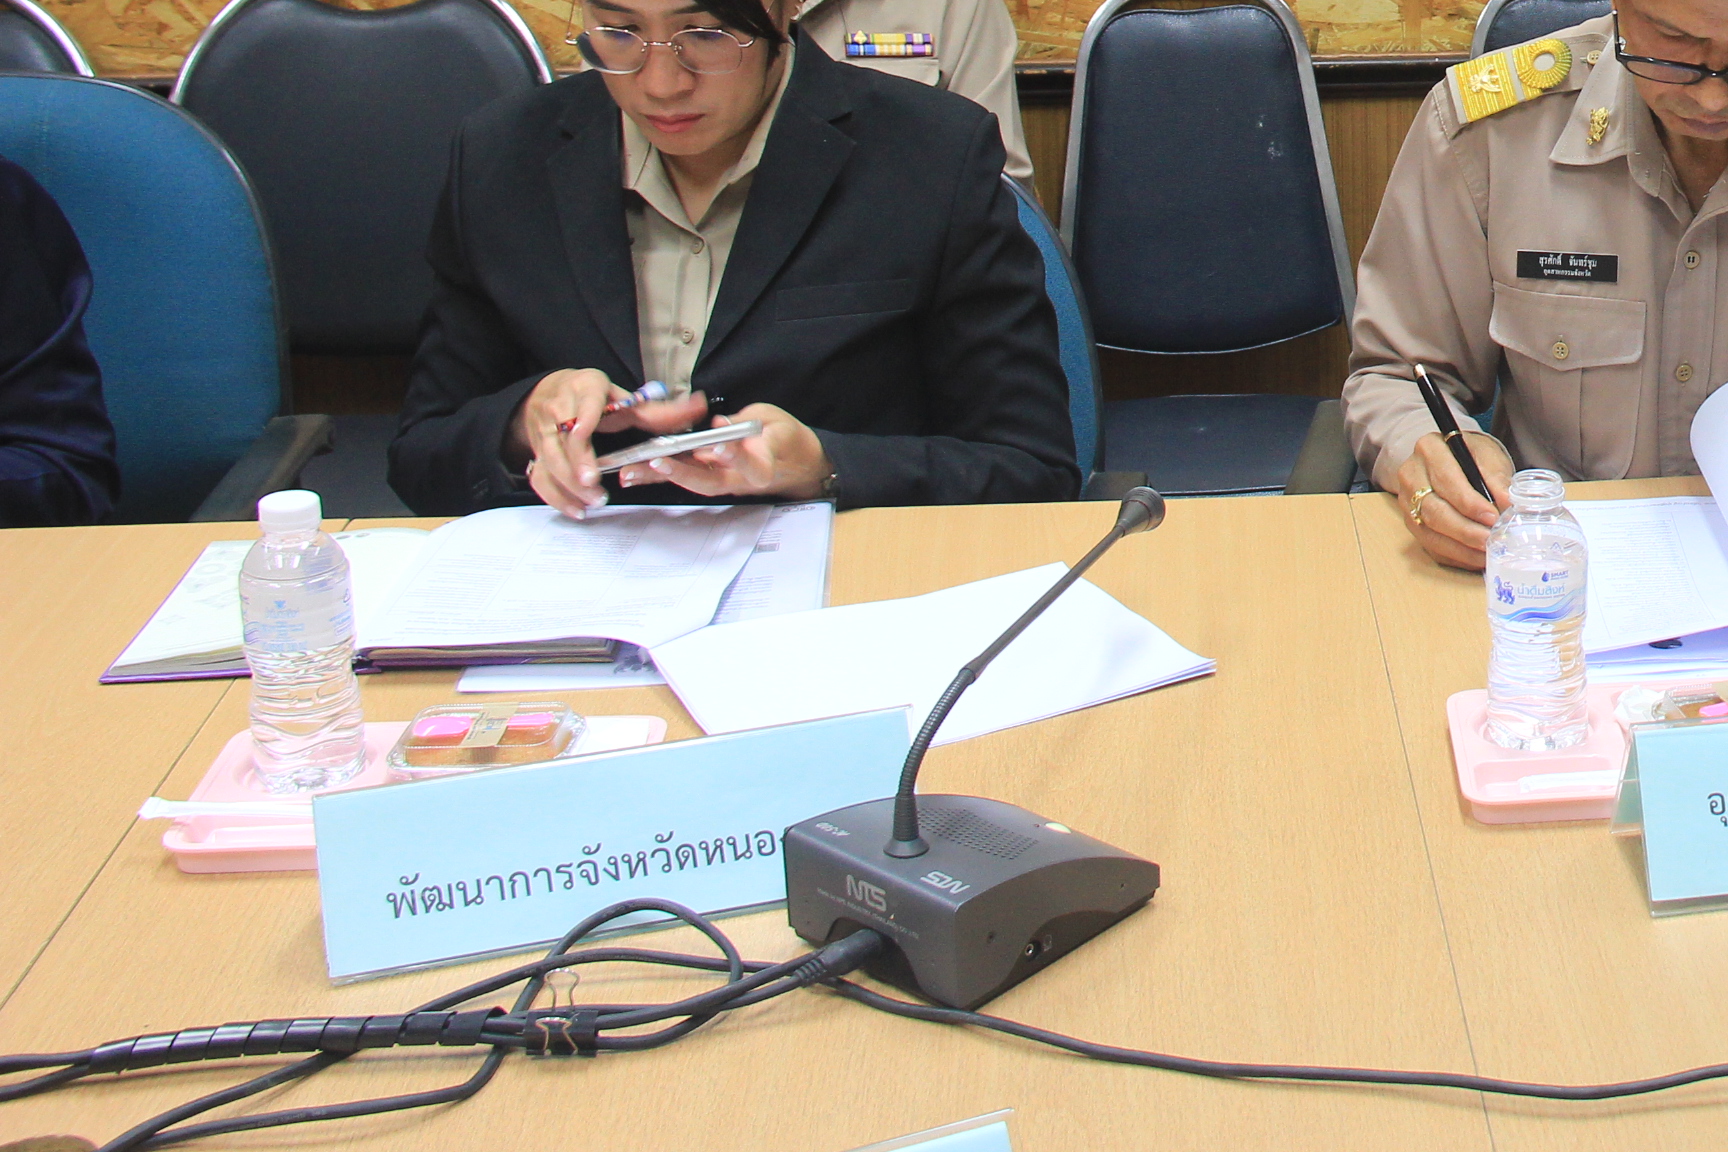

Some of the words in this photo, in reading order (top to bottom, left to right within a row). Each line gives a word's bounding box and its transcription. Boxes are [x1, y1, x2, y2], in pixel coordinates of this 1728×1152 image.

[385, 830, 786, 919] พัฒนาการจังหวัดหนอ
